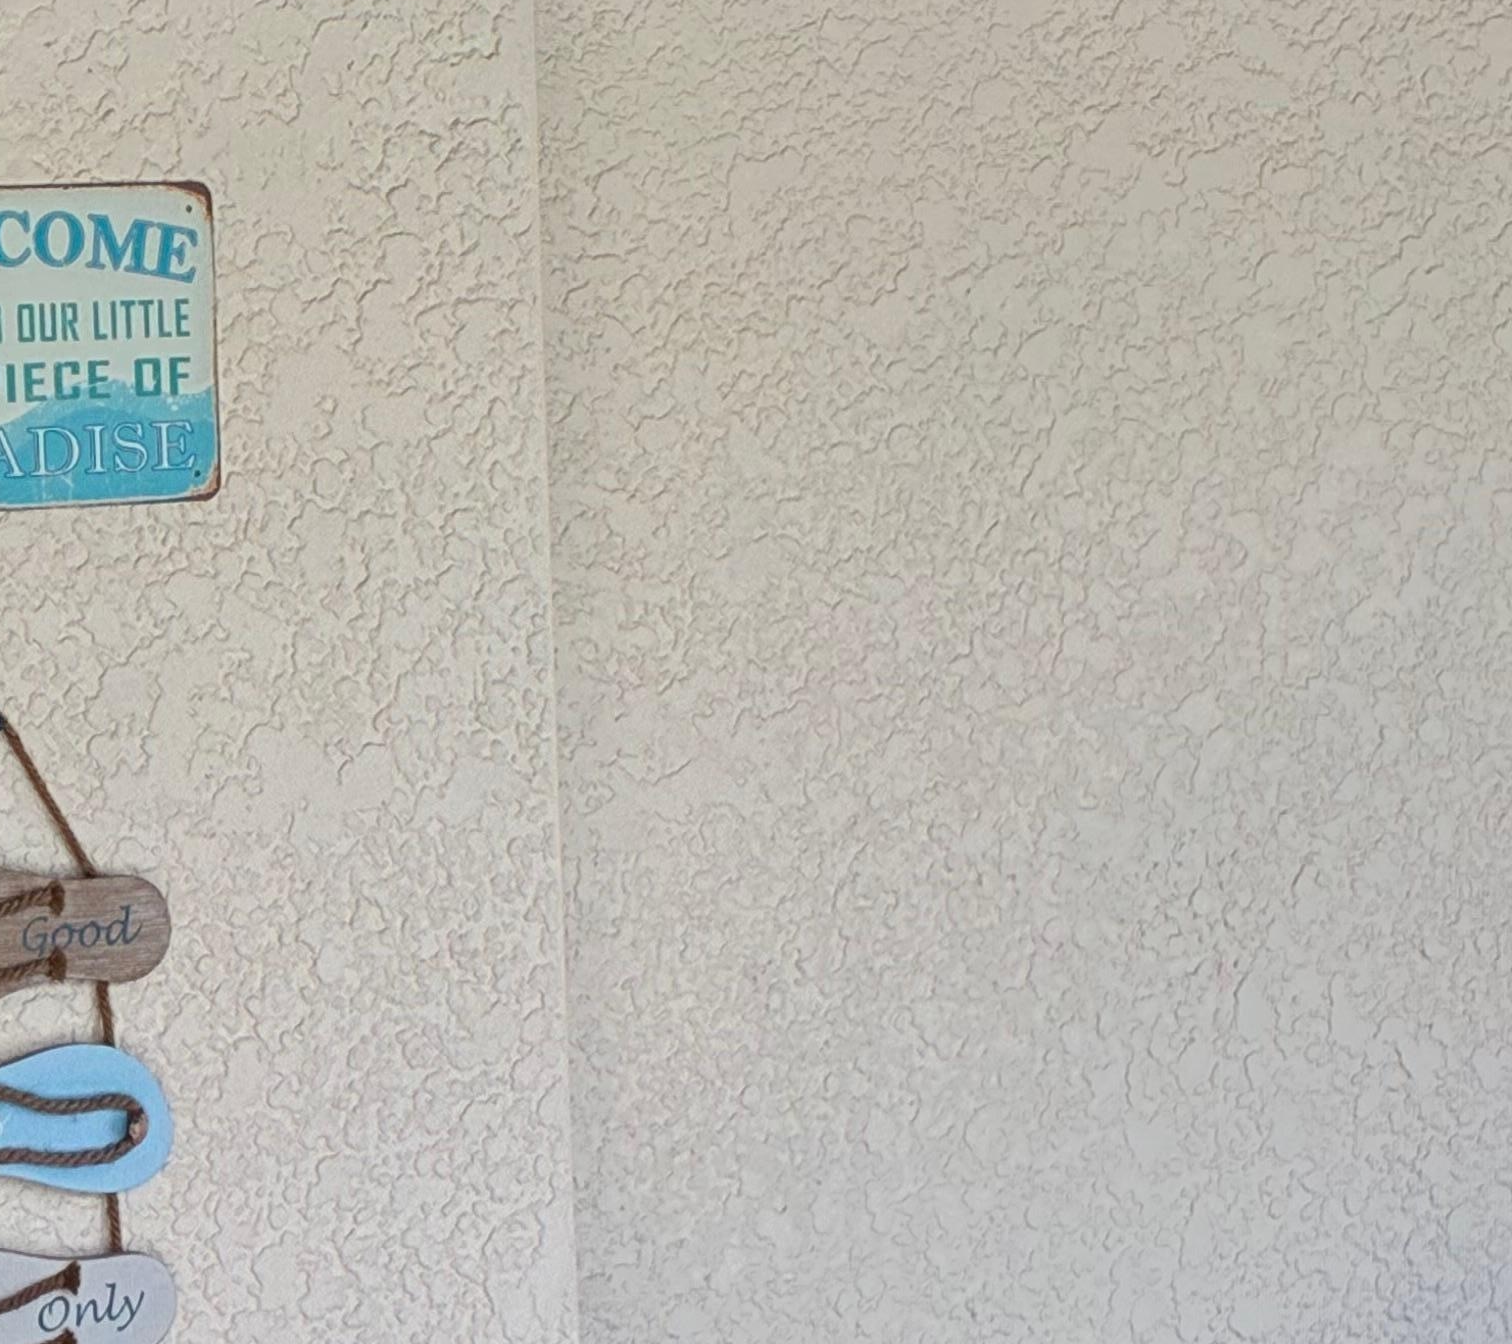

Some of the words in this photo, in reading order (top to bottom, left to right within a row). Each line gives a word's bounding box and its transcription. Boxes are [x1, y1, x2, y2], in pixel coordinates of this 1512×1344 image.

[16, 302, 80, 344] OUR
[93, 298, 192, 341] LITTLE
[134, 356, 192, 398] OF
[22, 904, 143, 957] Good
[37, 1283, 145, 1333] Only
